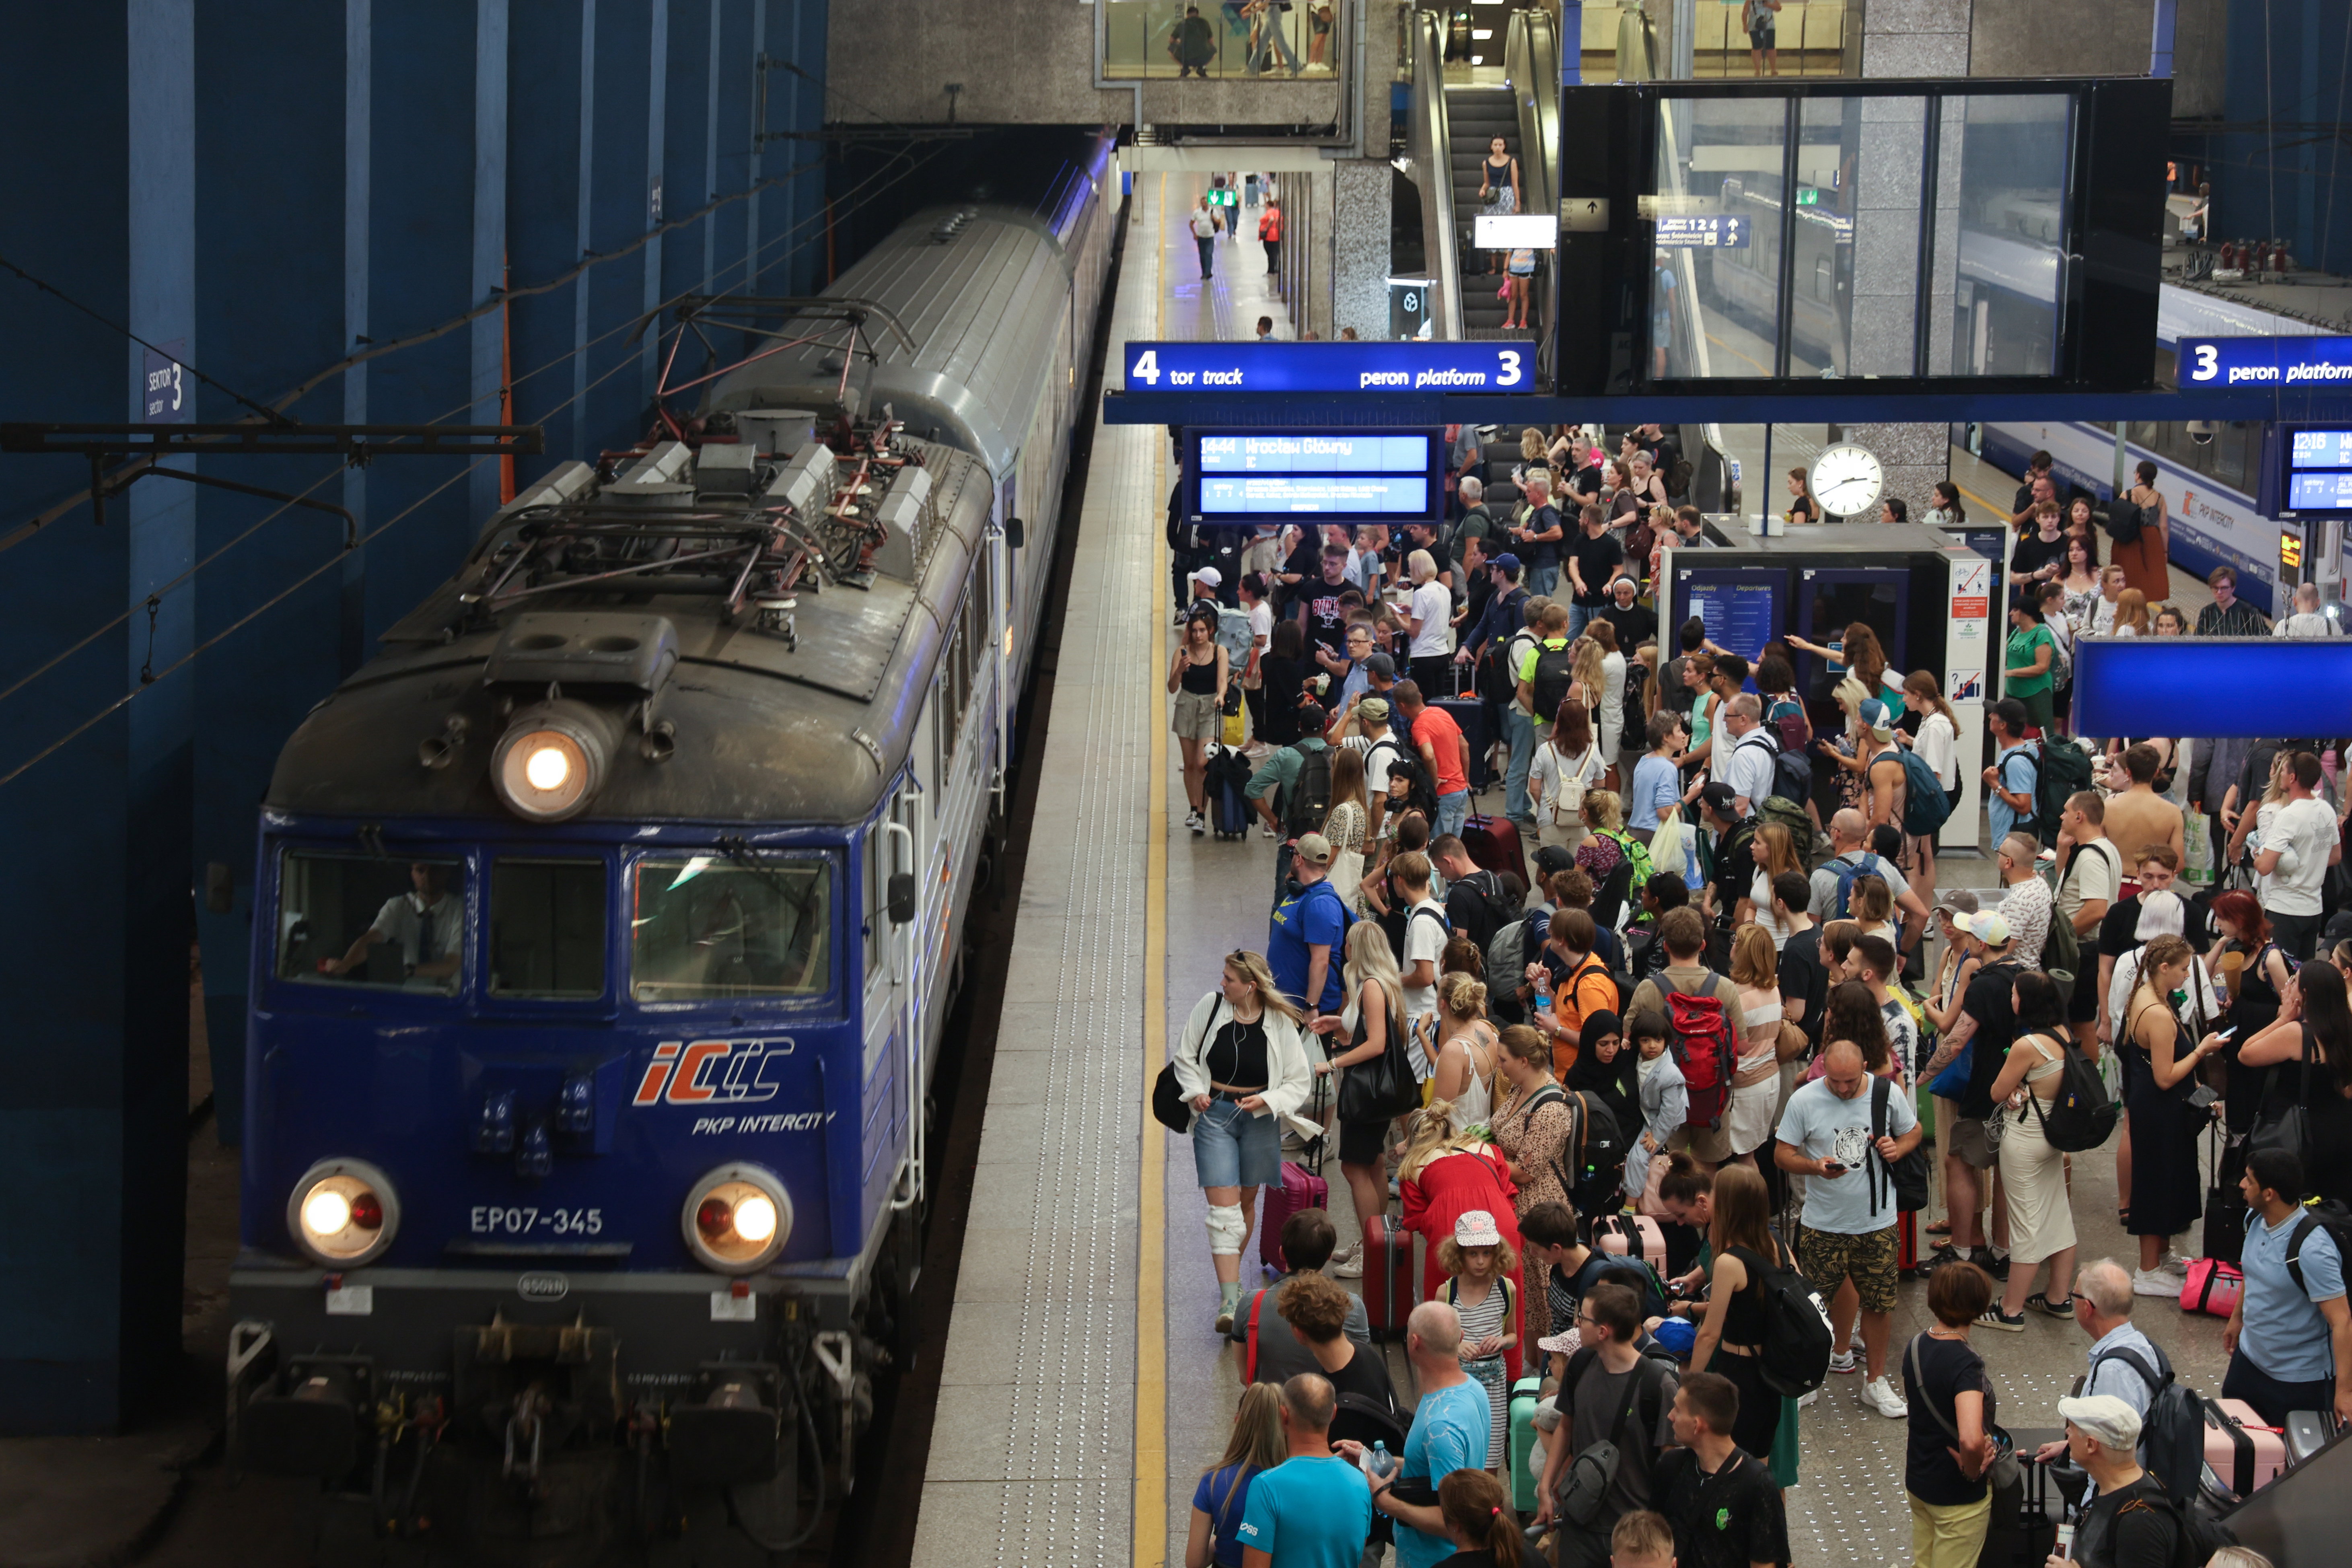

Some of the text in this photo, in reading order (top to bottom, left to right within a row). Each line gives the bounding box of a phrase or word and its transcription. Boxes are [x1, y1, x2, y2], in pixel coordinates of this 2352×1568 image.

[1689, 219, 1695, 231] 1
[1698, 219, 1706, 231] 2
[1710, 219, 1718, 231] 4
[1133, 350, 1521, 389] 4 tor track peron platform 3
[2192, 345, 2218, 381] 3
[2229, 366, 2279, 384] peron
[149, 362, 182, 411] SEKTOR 3
[149, 399, 164, 416] sector
[1201, 438, 1352, 455] 14:44 Wrocław Główny
[2293, 433, 2326, 450] 12:16
[1246, 457, 1256, 468] IC
[2339, 451, 2350, 464] IC
[691, 1110, 838, 1136] PKP INTERCITY
[471, 1206, 603, 1235] EP07-345
[1240, 1521, 1259, 1536] OSS
